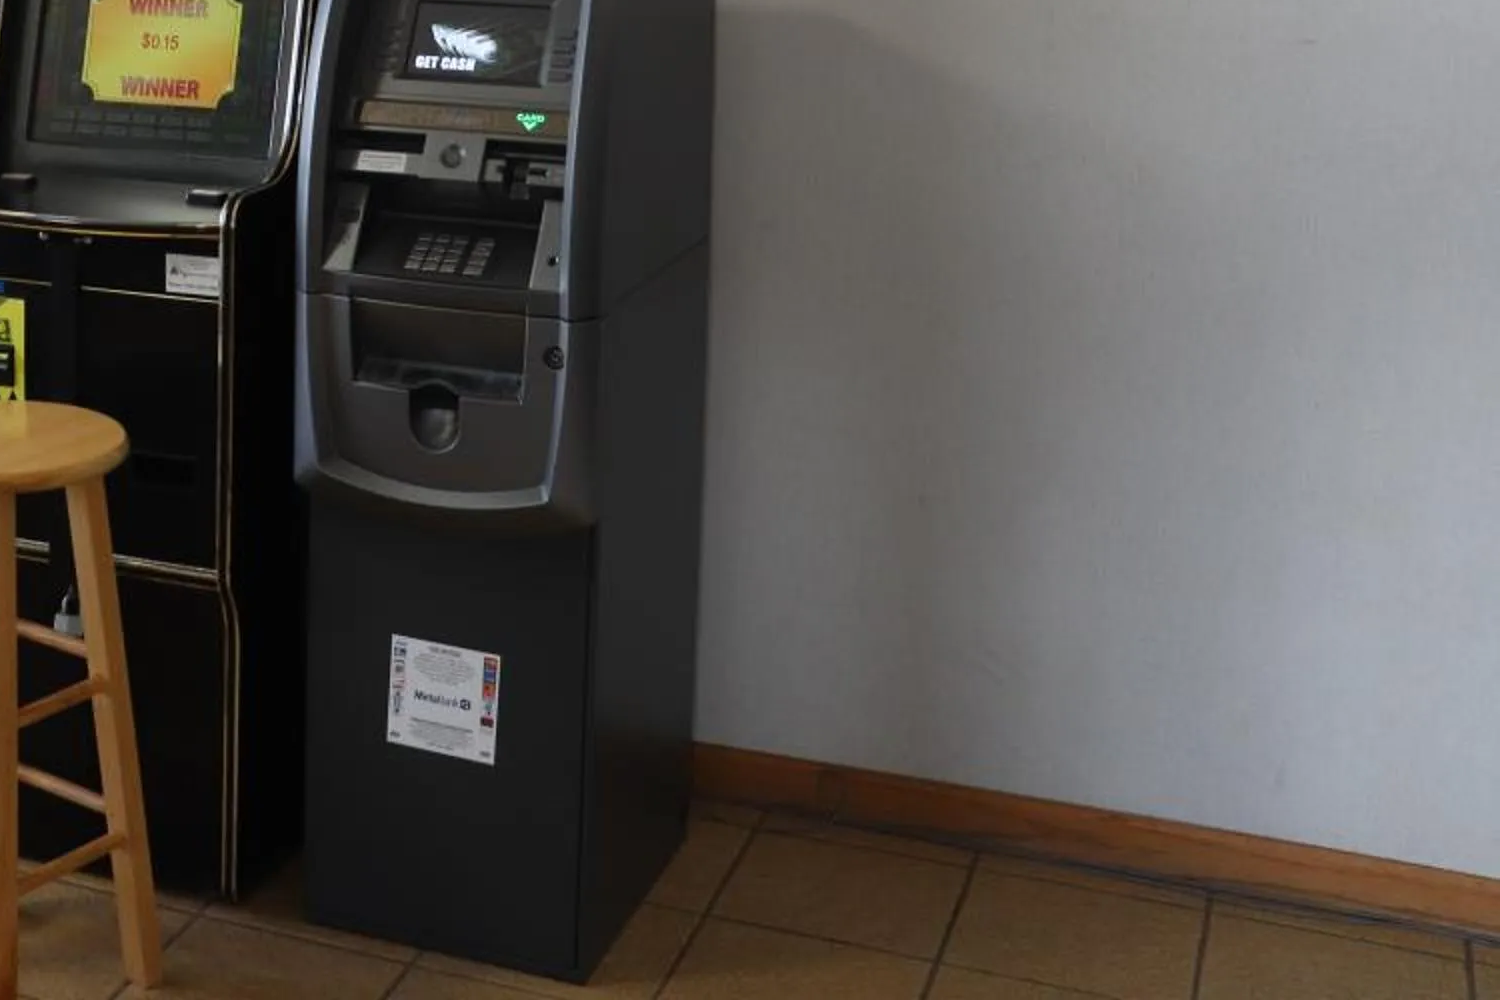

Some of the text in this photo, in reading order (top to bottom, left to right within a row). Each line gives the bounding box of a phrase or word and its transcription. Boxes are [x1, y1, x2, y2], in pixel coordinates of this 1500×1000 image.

[141, 32, 180, 51] $0.15
[415, 55, 477, 72] GET CASH
[120, 75, 201, 99] WINNER
[516, 113, 546, 123] CARD
